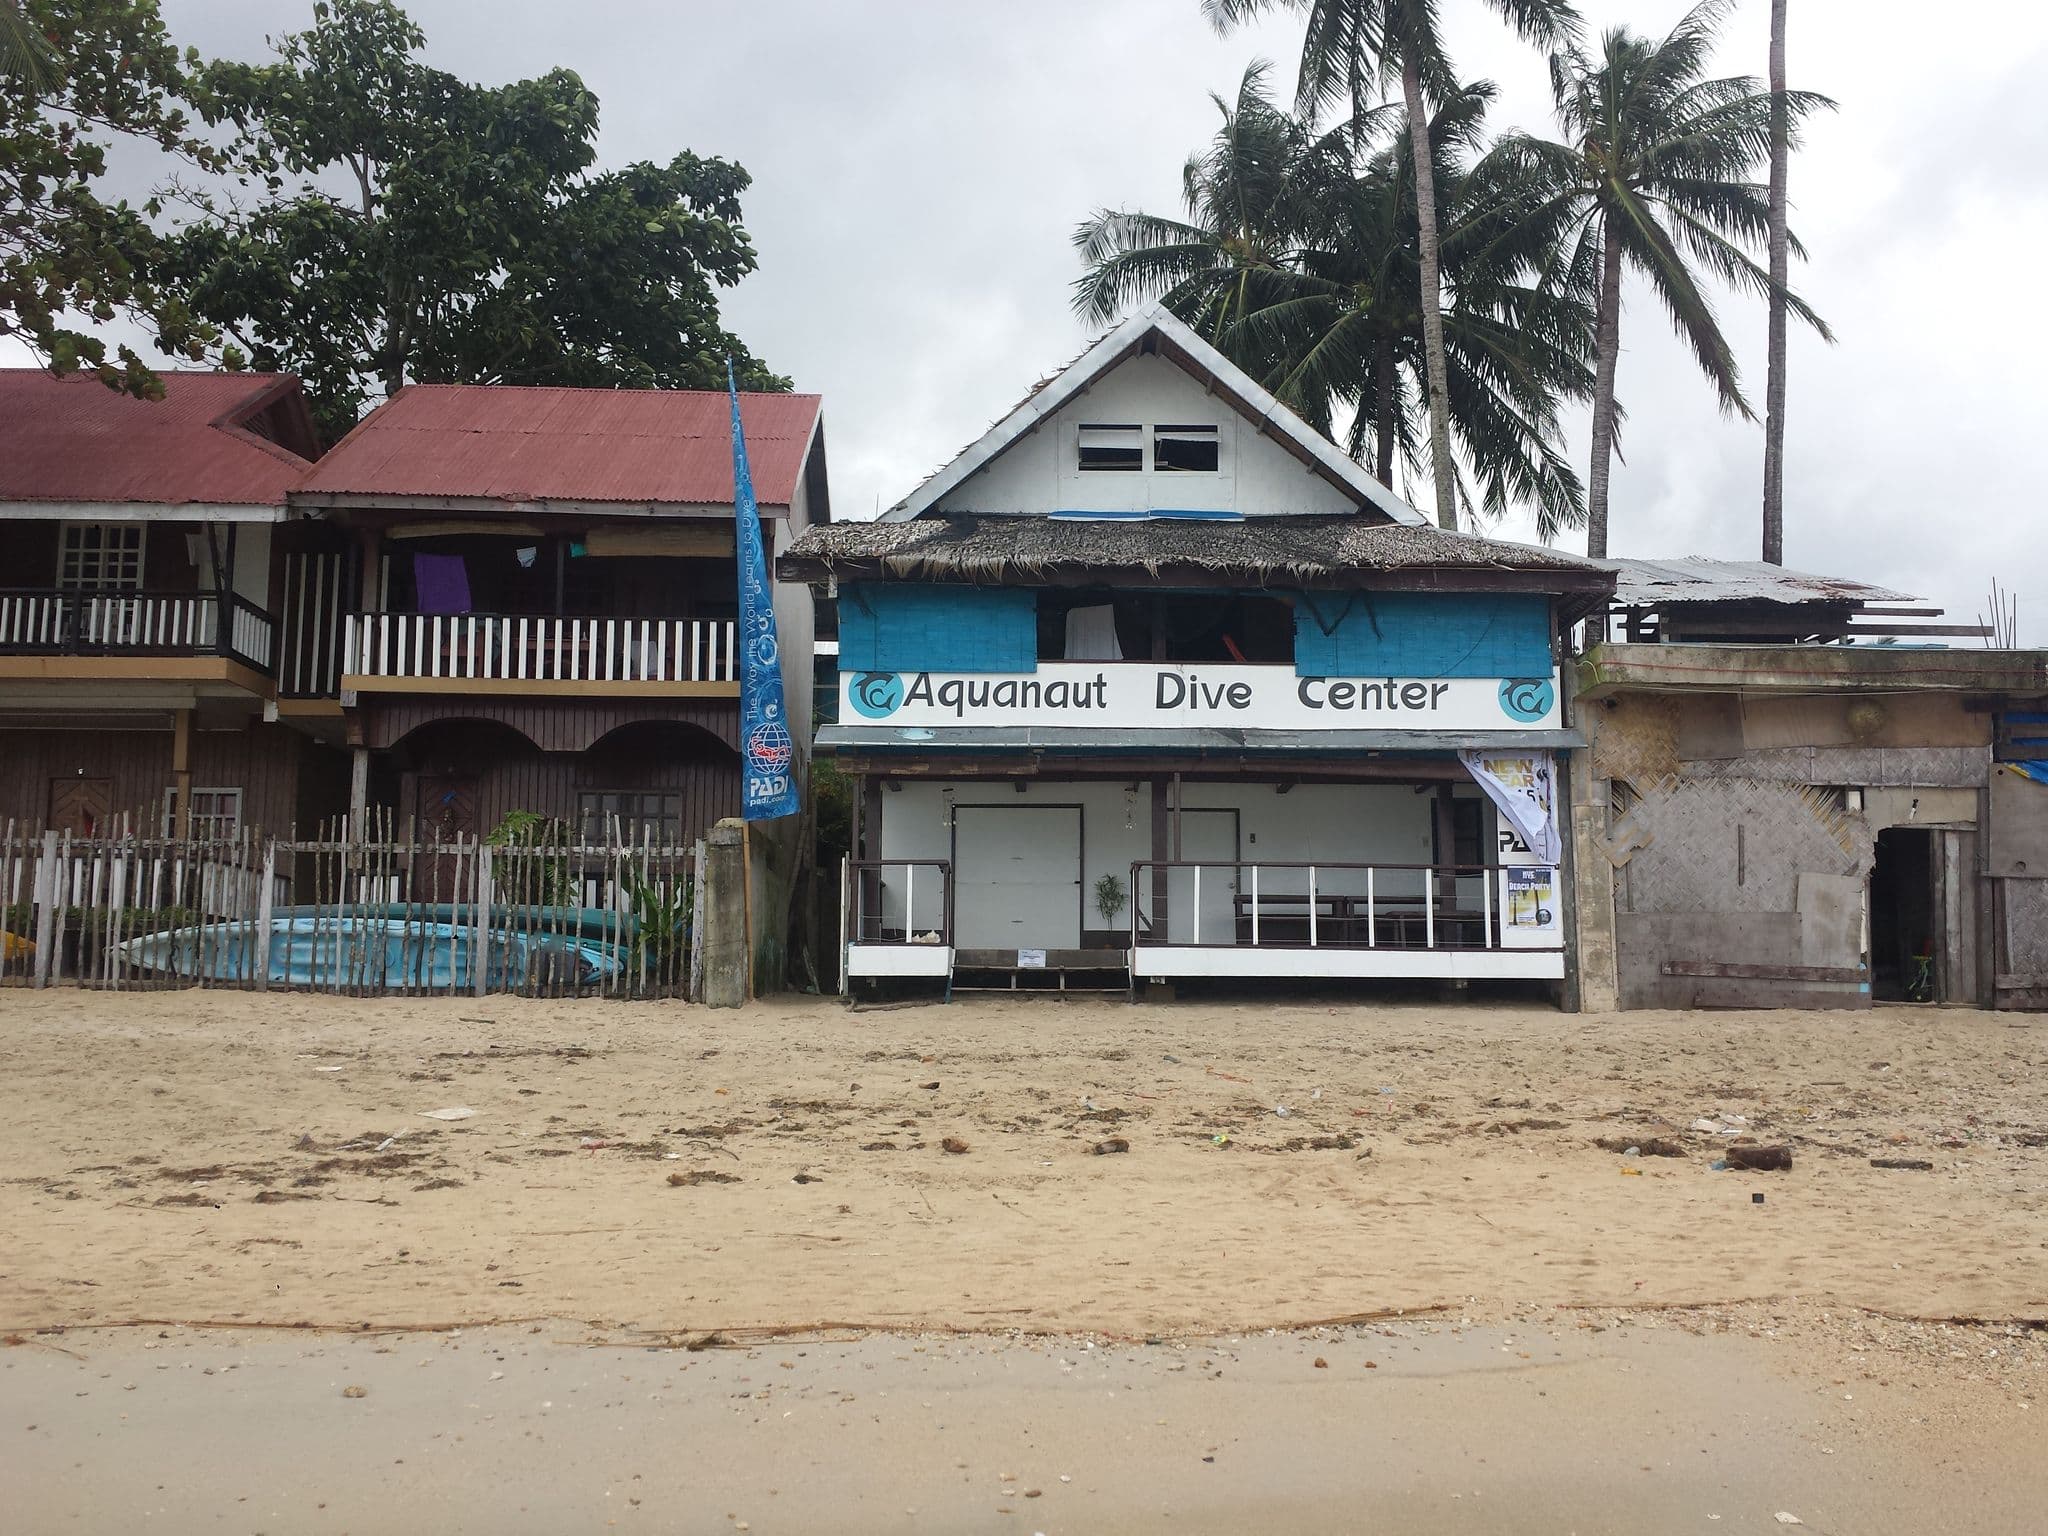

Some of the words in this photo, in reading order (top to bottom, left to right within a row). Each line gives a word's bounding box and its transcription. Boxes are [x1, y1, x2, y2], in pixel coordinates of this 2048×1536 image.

[745, 593, 758, 635] World
[746, 639, 757, 657] the
[747, 661, 759, 694] Way
[903, 673, 1108, 717] Aquanaut
[1155, 672, 1252, 709] Dive
[1298, 677, 1448, 710] Center
[747, 698, 757, 721] The
[1484, 759, 1533, 773] NEW
[750, 776, 789, 797] PADI
